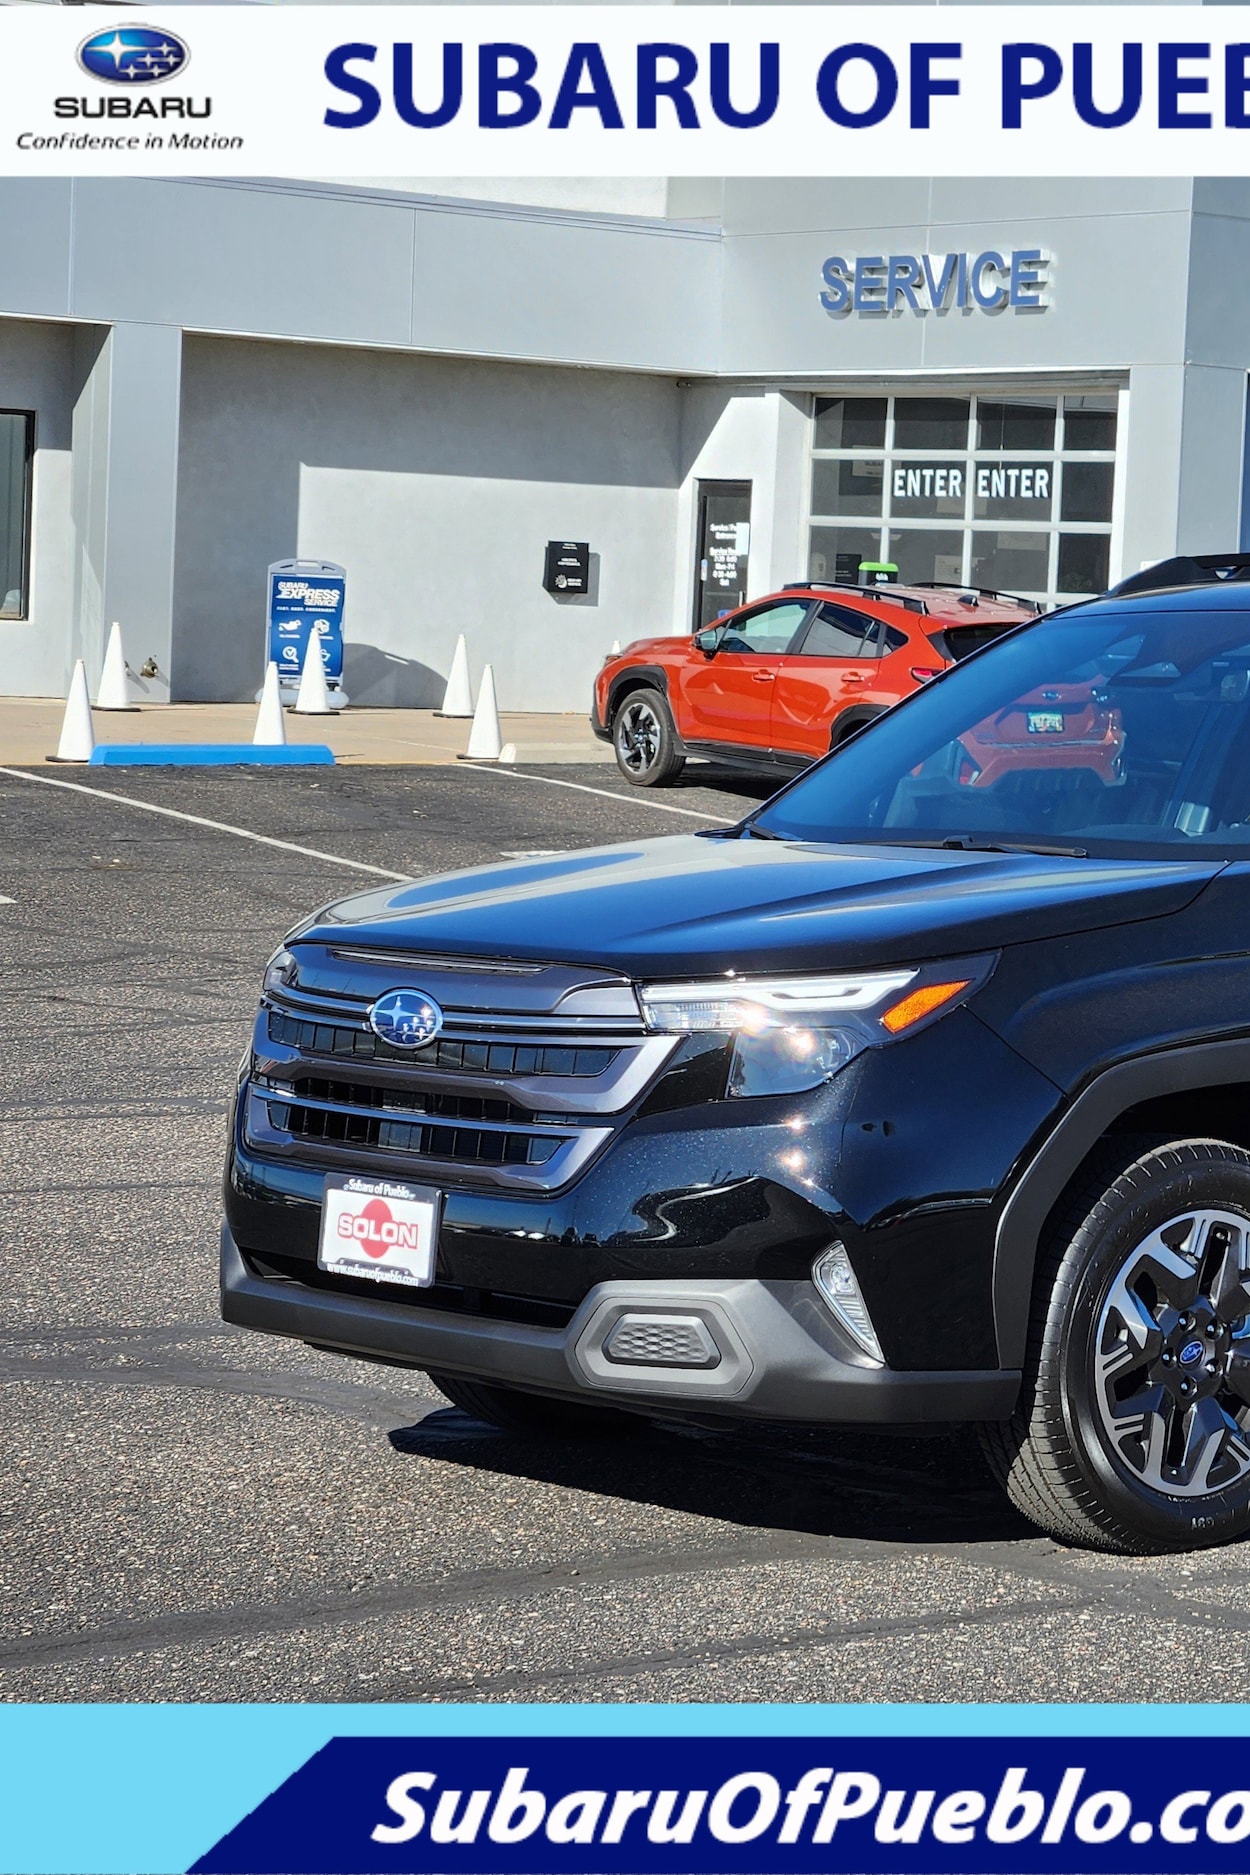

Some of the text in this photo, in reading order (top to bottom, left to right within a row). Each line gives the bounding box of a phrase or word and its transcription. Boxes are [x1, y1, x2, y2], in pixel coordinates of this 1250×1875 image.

[818, 248, 1050, 313] SERVICE
[893, 468, 963, 498] ENTER
[976, 468, 1050, 498] ENTER
[276, 588, 340, 600] EXPRESS
[349, 1178, 410, 1198] Subaru of Pueblo
[337, 1212, 419, 1250] SOLON
